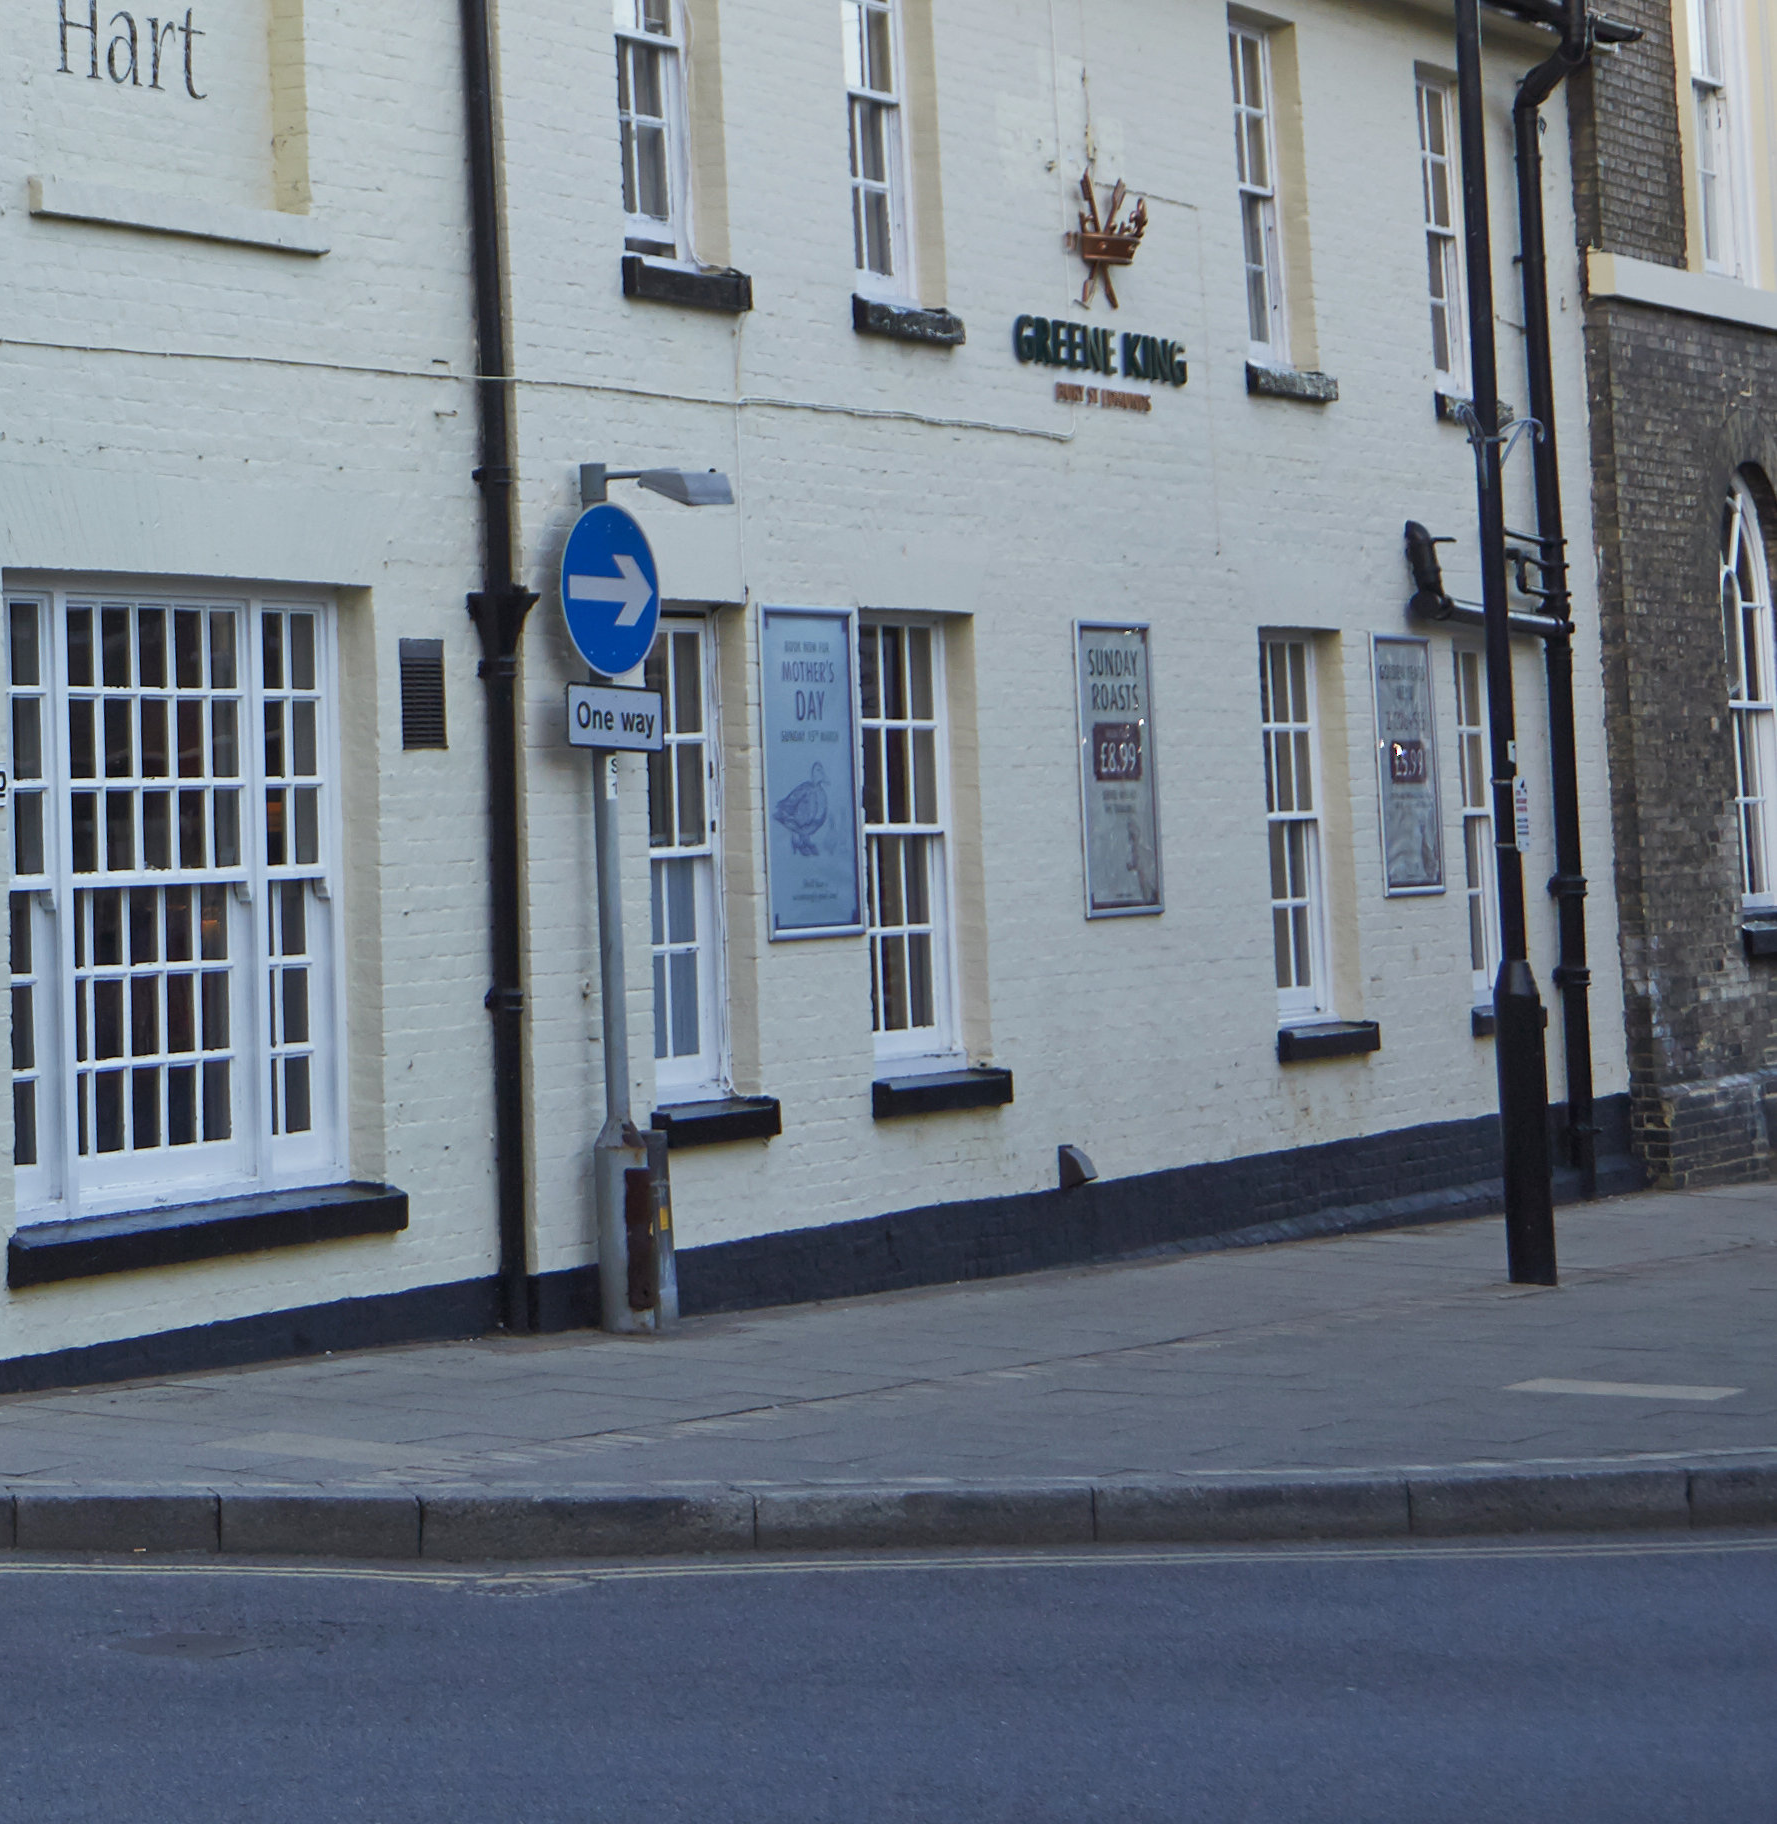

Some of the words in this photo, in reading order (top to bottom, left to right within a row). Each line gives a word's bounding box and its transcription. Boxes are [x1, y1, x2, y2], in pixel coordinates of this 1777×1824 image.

[1013, 314, 1118, 376] GREENE
[1122, 332, 1187, 387] KING
[782, 660, 835, 683] MOTHER'S
[1089, 648, 1138, 677] SUNDAY
[796, 690, 825, 721] DAY
[1091, 683, 1139, 711] ROASTS
[577, 701, 614, 730] One
[621, 711, 654, 739] way
[1100, 741, 1136, 773] £8.99
